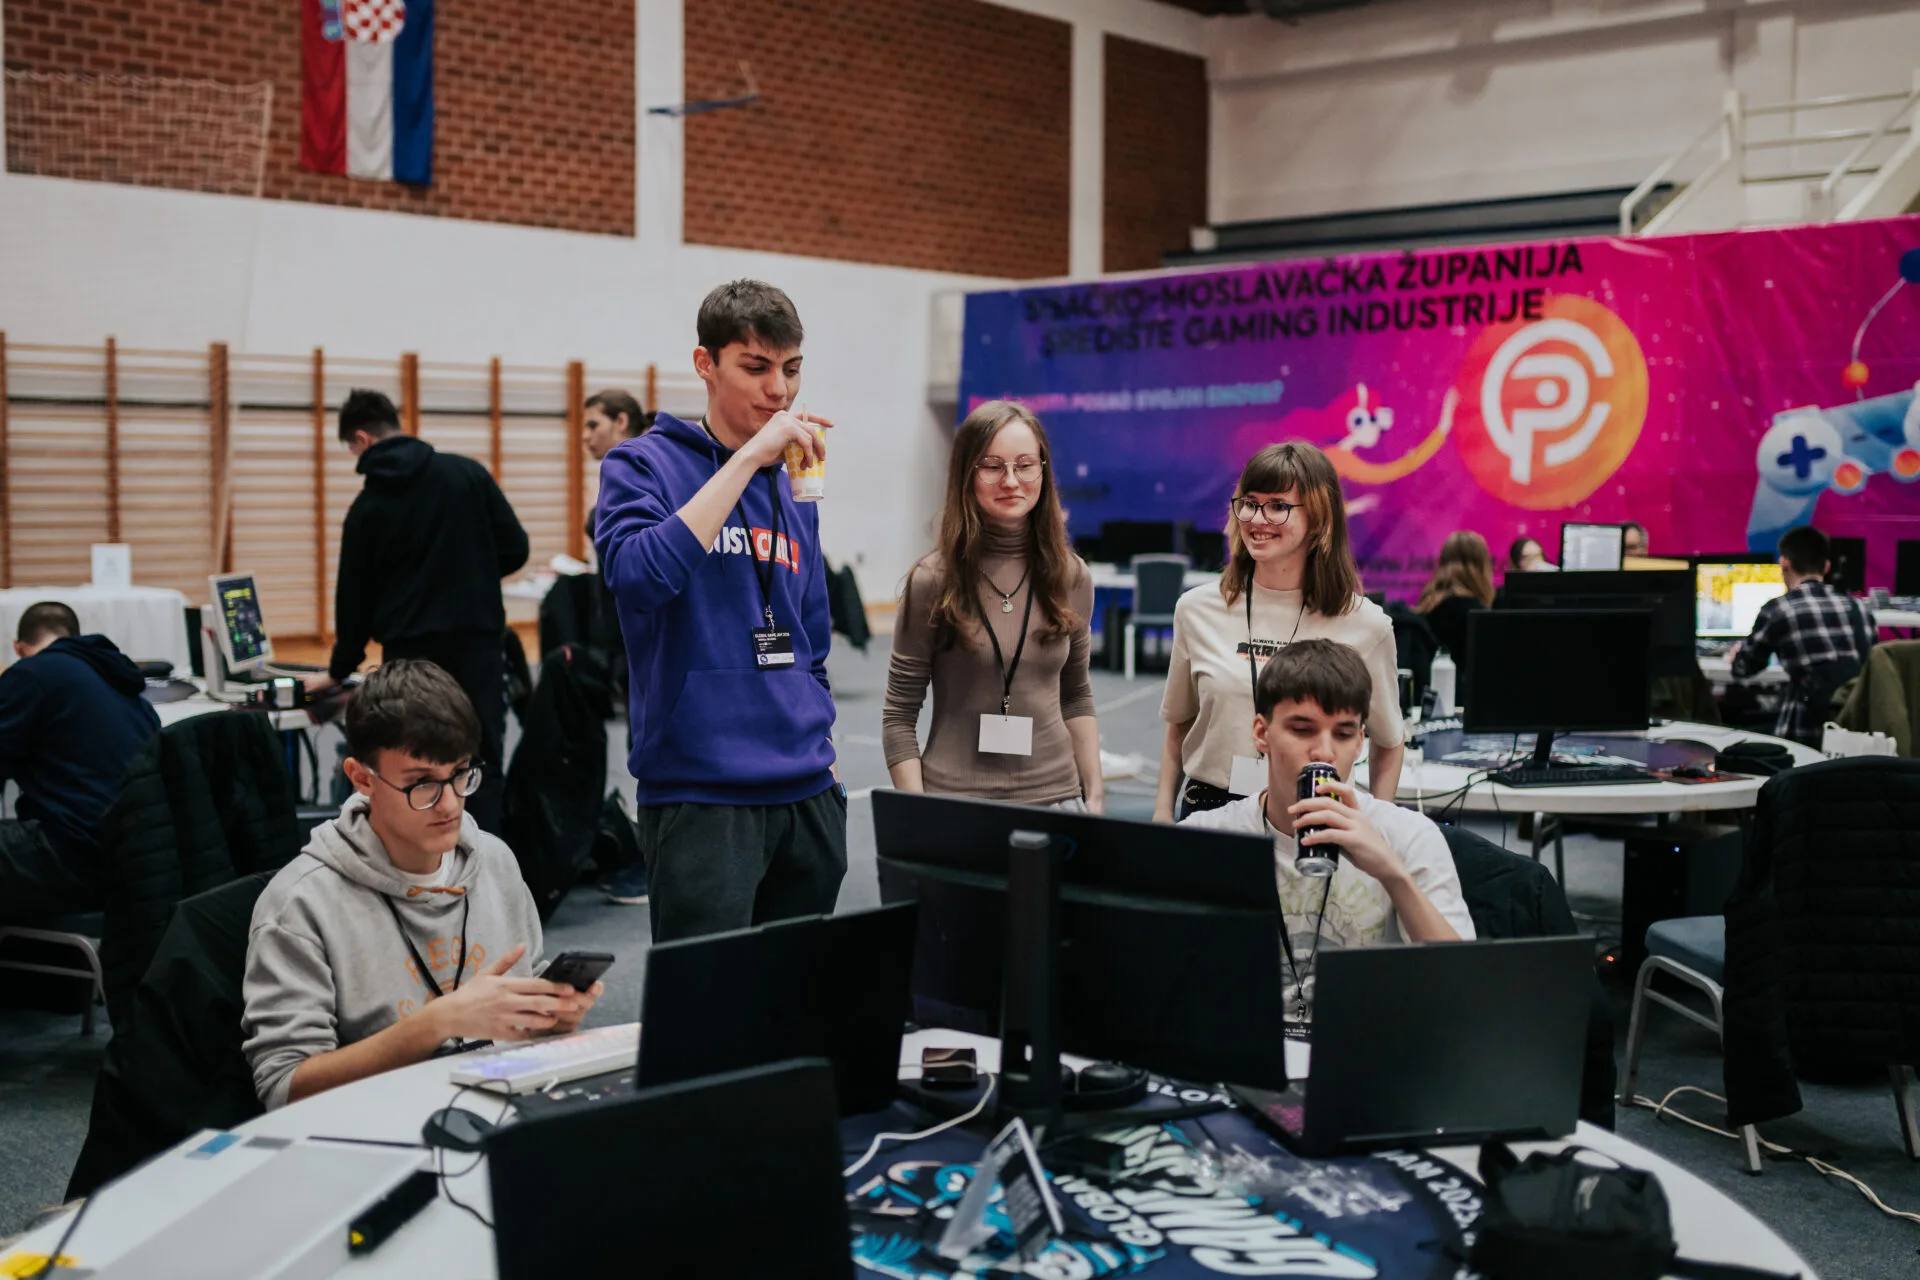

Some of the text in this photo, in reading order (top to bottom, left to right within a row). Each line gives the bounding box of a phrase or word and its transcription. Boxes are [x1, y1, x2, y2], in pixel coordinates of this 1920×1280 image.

[1396, 245, 1583, 290] ŽUPANIJA
[1184, 309, 1318, 346] GAMING
[1329, 288, 1545, 336] INDUSTRIJE
